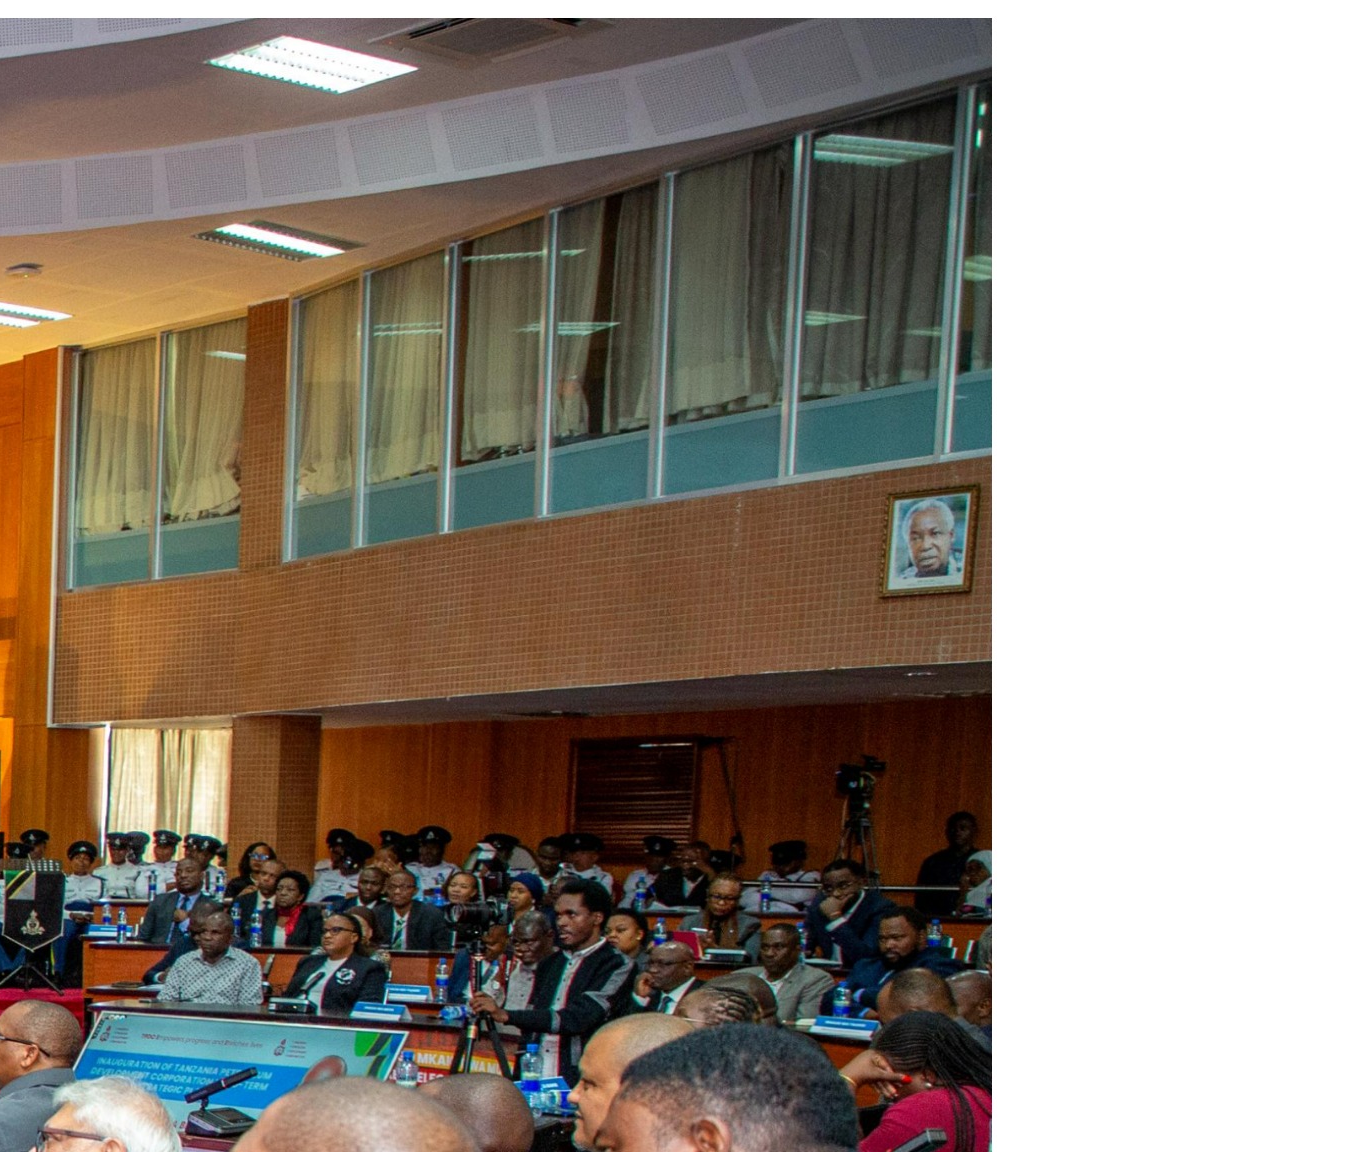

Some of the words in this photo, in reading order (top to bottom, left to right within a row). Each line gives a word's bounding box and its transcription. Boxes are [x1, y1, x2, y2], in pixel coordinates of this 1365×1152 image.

[96, 1057, 161, 1070] INAUGURATION
[162, 1062, 173, 1071] OF
[174, 1063, 218, 1075] TANZANIA
